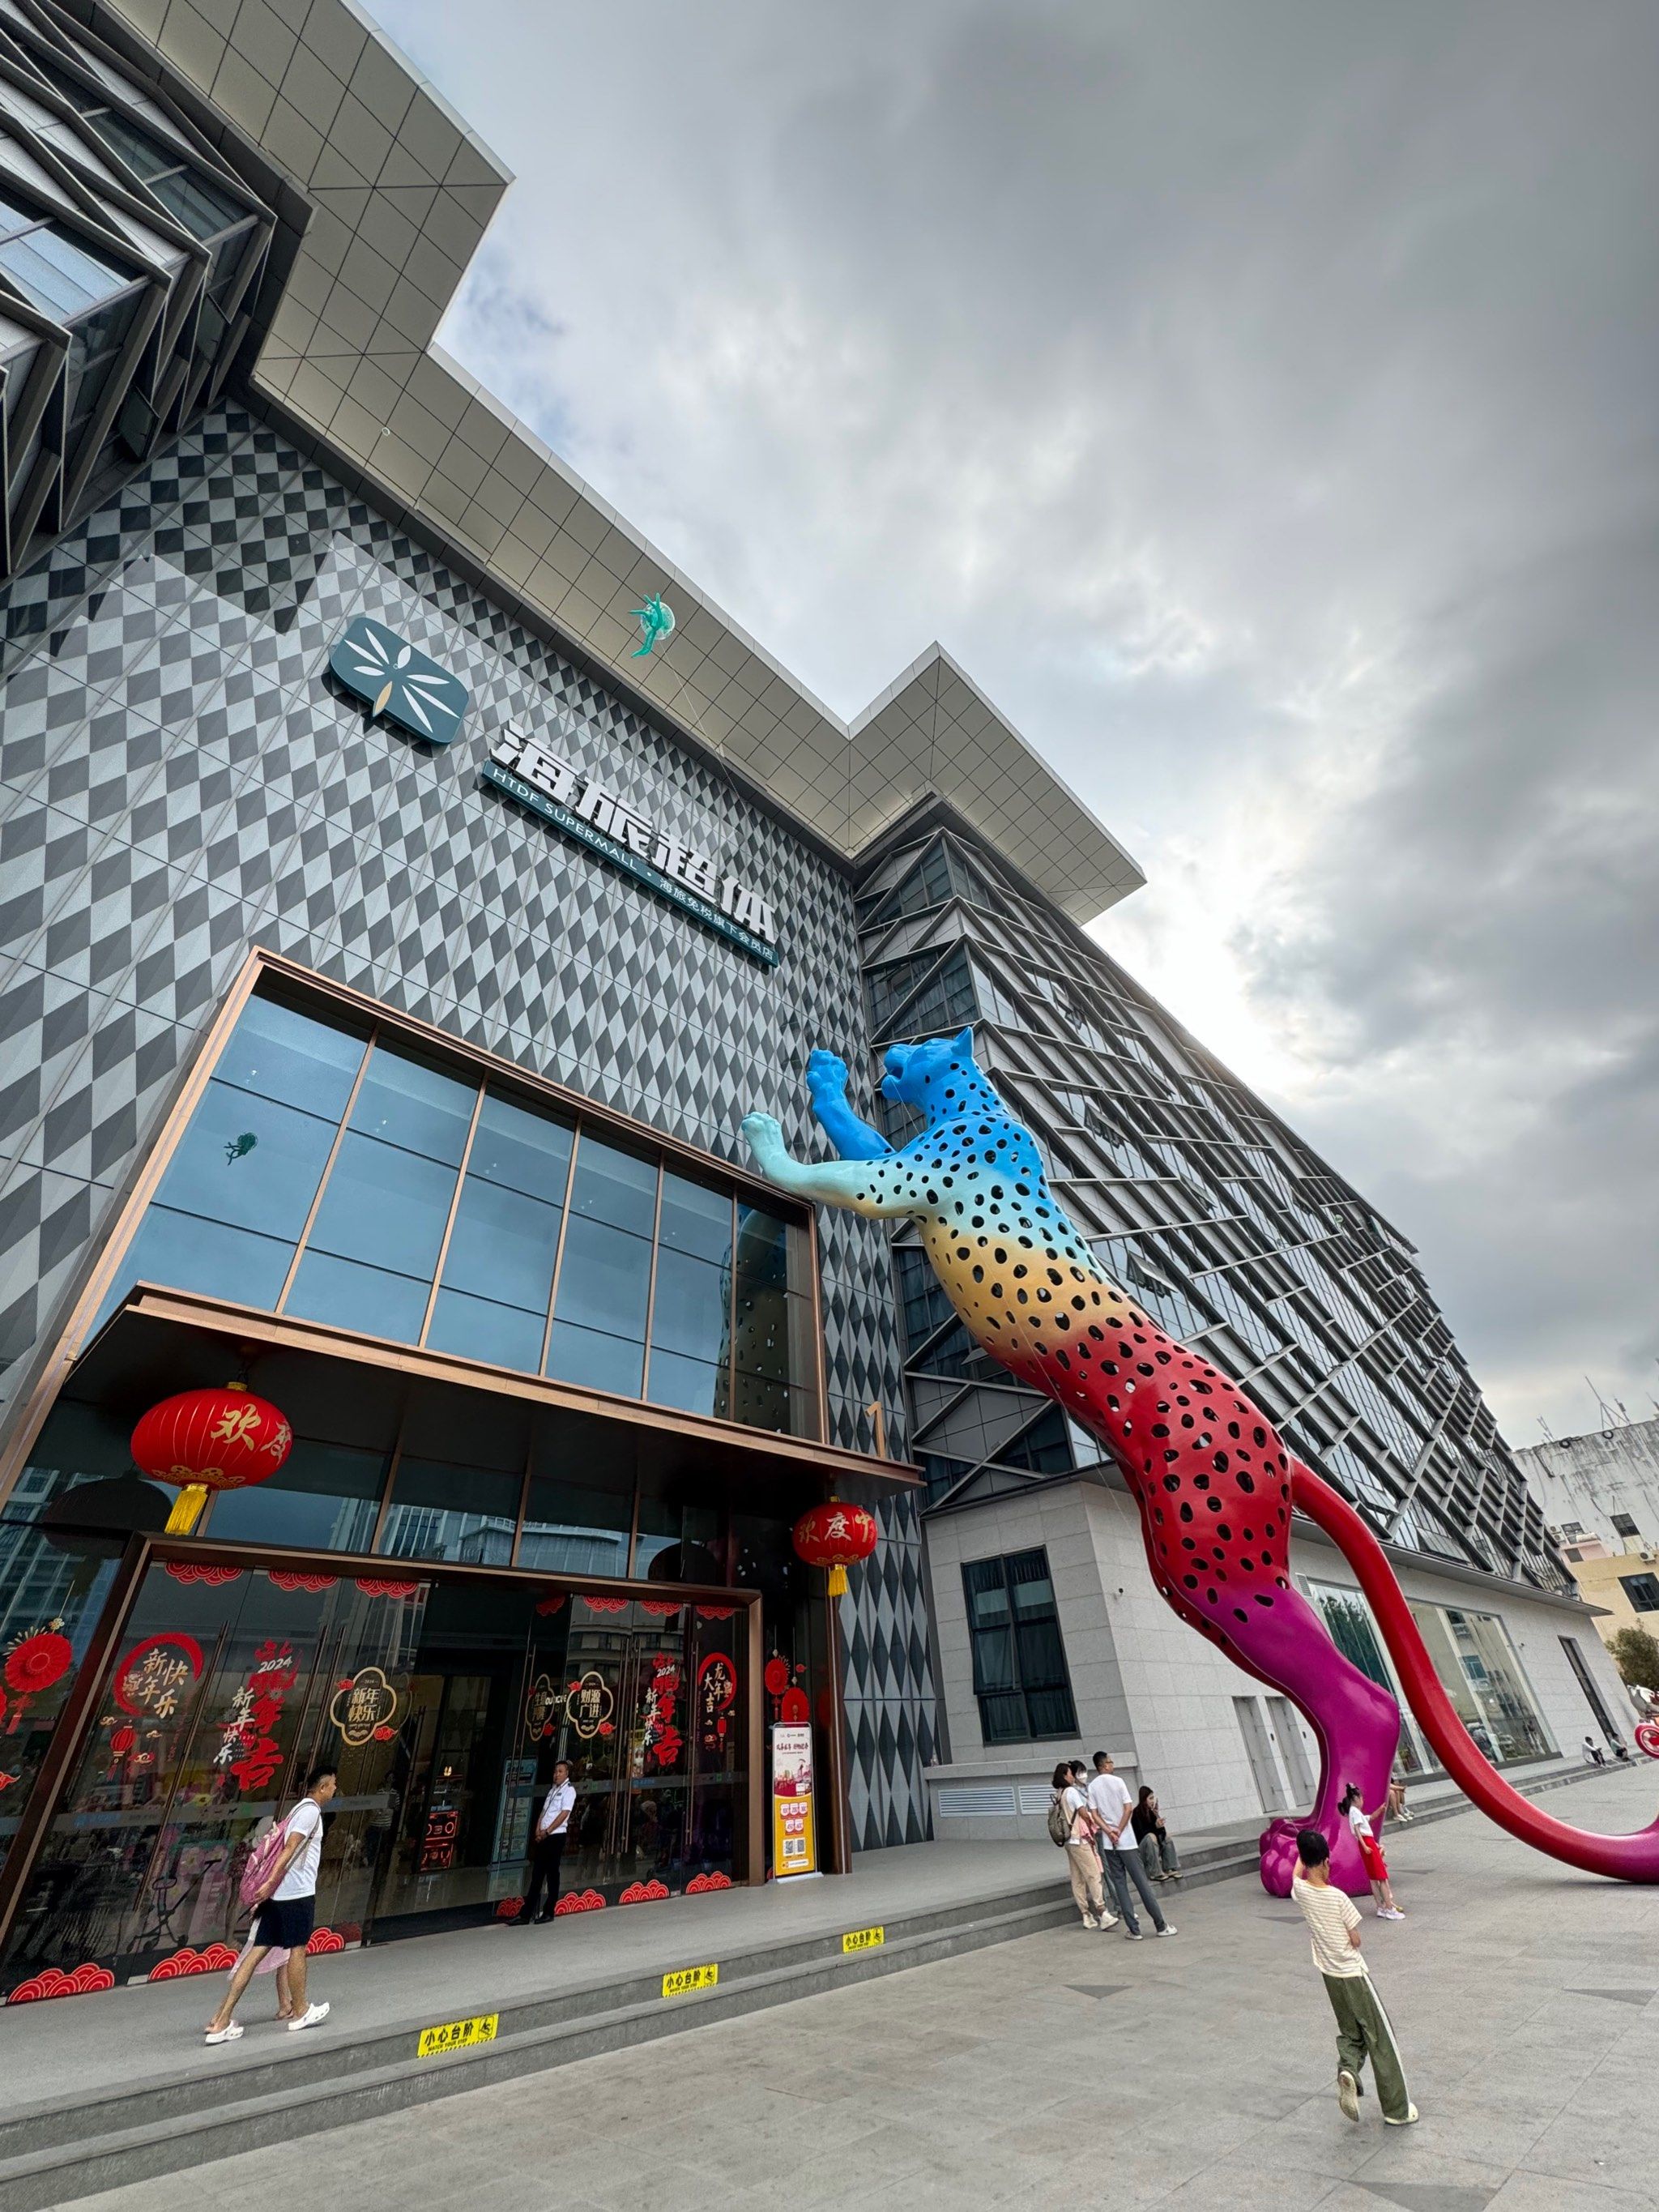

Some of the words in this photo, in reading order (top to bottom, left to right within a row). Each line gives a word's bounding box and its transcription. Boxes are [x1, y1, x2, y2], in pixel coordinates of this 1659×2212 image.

[489, 719, 775, 946] 海旅超体
[493, 768, 540, 803] HTDF
[544, 802, 638, 871] SUPERMALL
[659, 877, 774, 961] 海旅免税旗下会员店
[864, 1401, 885, 1458] 1
[257, 1655, 293, 1674] 2024
[656, 1664, 676, 1678] 2024
[352, 1687, 381, 1705] 新年
[580, 1689, 601, 1704] 财源
[703, 1672, 715, 1713] 大吉
[348, 1704, 378, 1723] 快乐
[578, 1703, 599, 1718] 广进
[642, 1687, 661, 1746] 新年快乐
[213, 1685, 256, 1766] 新年快乐
[666, 1970, 701, 1989] 小心台阶
[424, 2021, 474, 2047] 小心台阶
